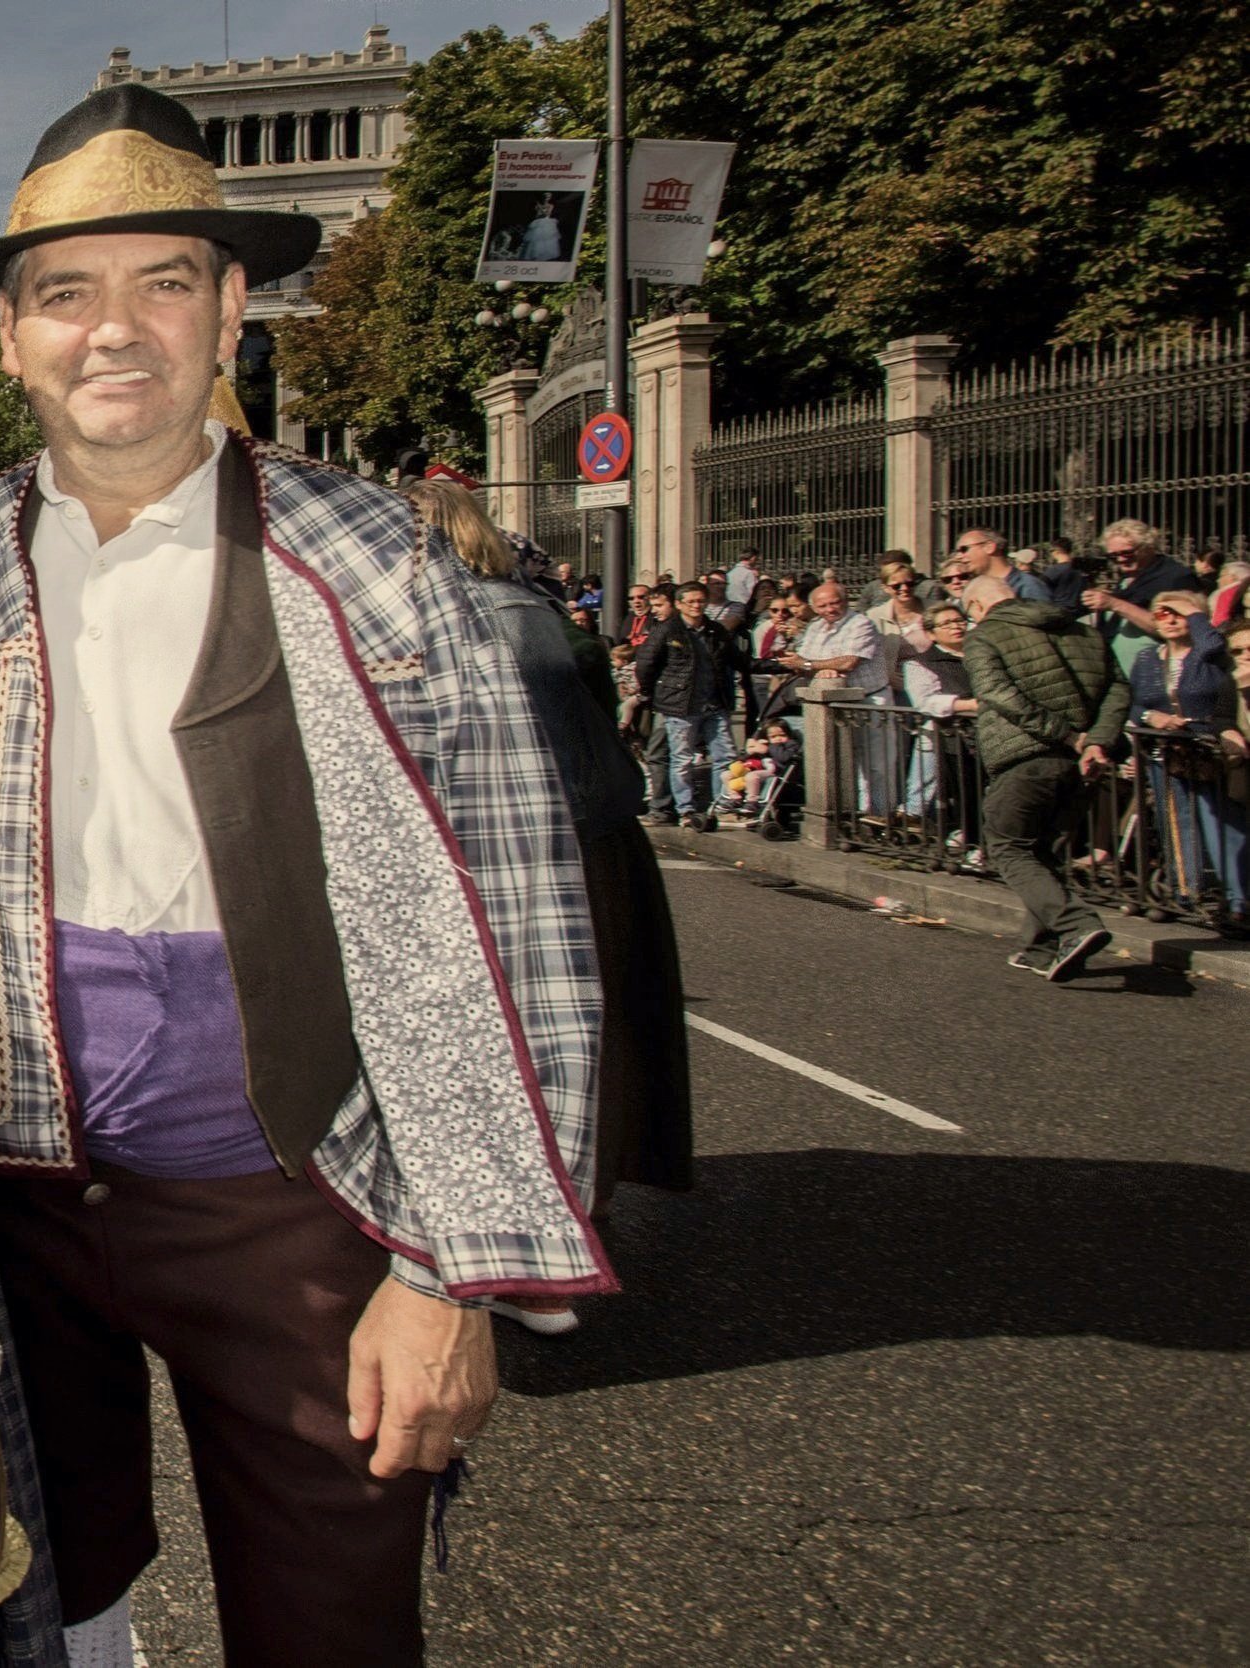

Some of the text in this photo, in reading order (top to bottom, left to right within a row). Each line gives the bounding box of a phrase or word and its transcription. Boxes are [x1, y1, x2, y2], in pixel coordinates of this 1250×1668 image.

[500, 151, 518, 160] Eva
[521, 151, 553, 160] Perón
[498, 162, 573, 171] El homosexual
[503, 265, 518, 275] 28
[633, 268, 674, 277] MADRID
